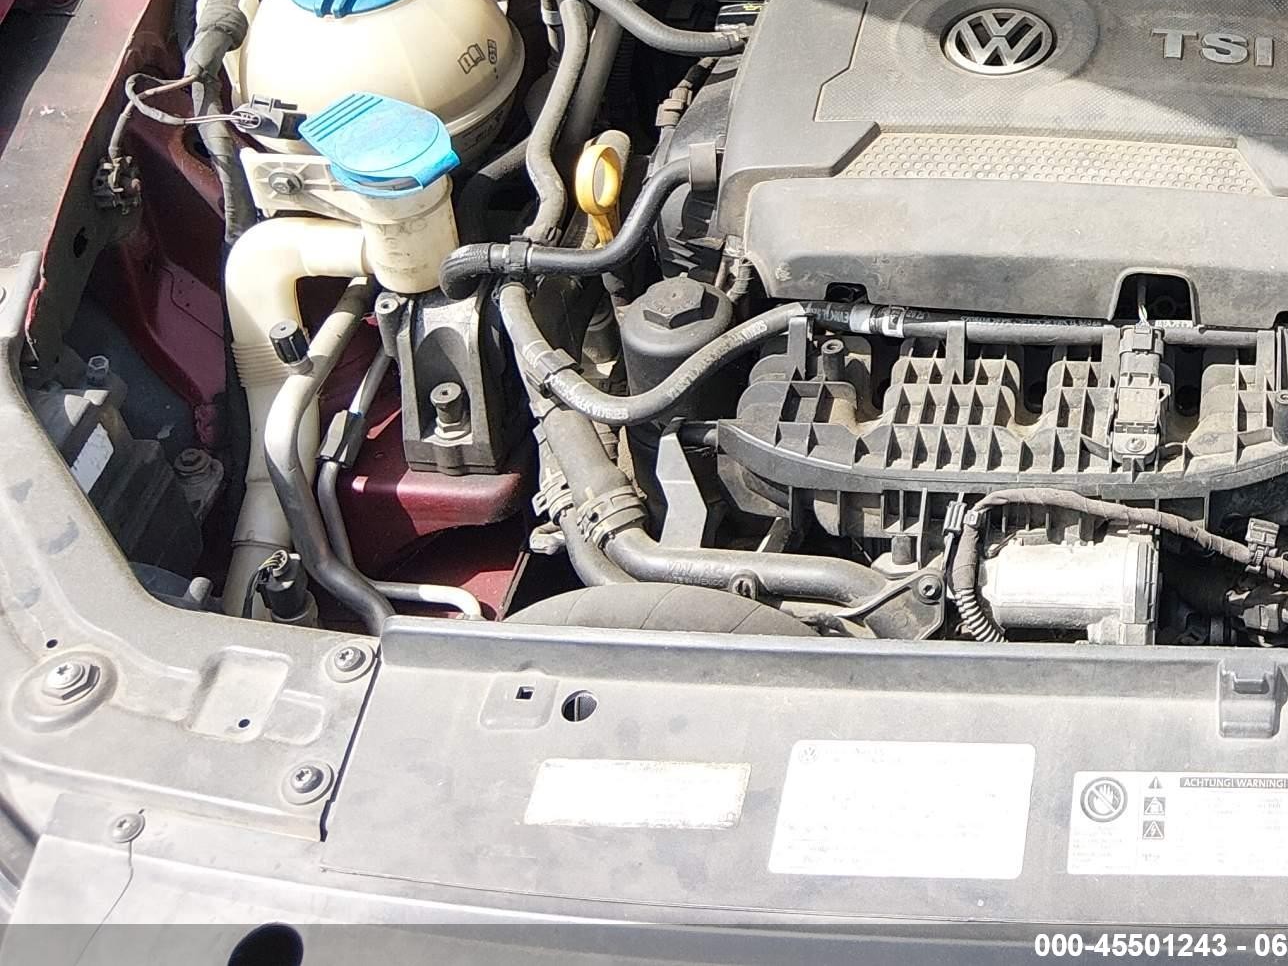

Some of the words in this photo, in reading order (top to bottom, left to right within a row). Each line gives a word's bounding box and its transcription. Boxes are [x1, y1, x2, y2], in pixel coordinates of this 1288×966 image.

[1151, 27, 1275, 68] TSI
[1183, 778, 1234, 788] ACHTUNG!
[1237, 779, 1286, 789] WARNING!
